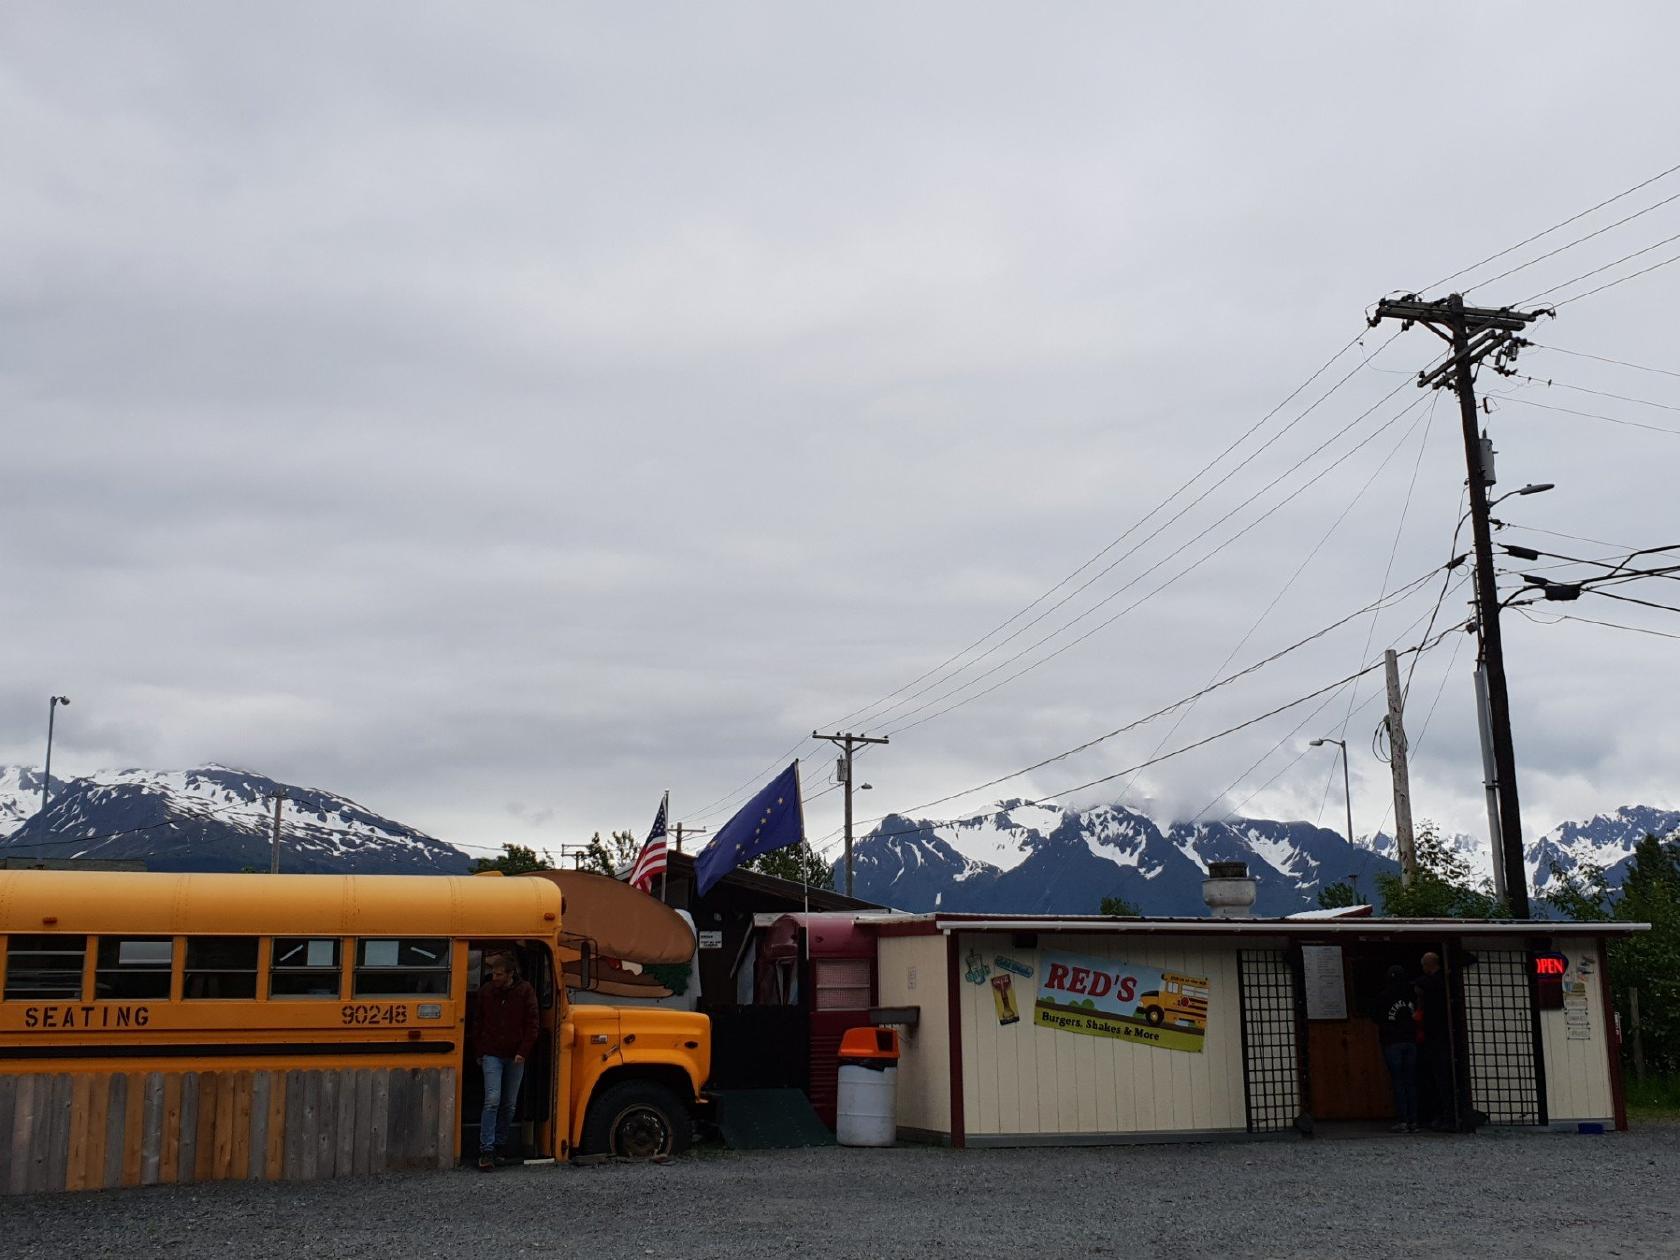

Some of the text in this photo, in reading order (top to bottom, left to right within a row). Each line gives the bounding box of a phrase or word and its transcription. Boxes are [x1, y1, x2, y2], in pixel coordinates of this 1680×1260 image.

[1044, 963, 1138, 1002] RED'S
[25, 1006, 149, 1028] SEATING
[341, 1004, 407, 1025] 90248
[1086, 1019, 1121, 1035] Shakes
[1124, 1026, 1132, 1036] &
[1134, 1027, 1160, 1041] More
